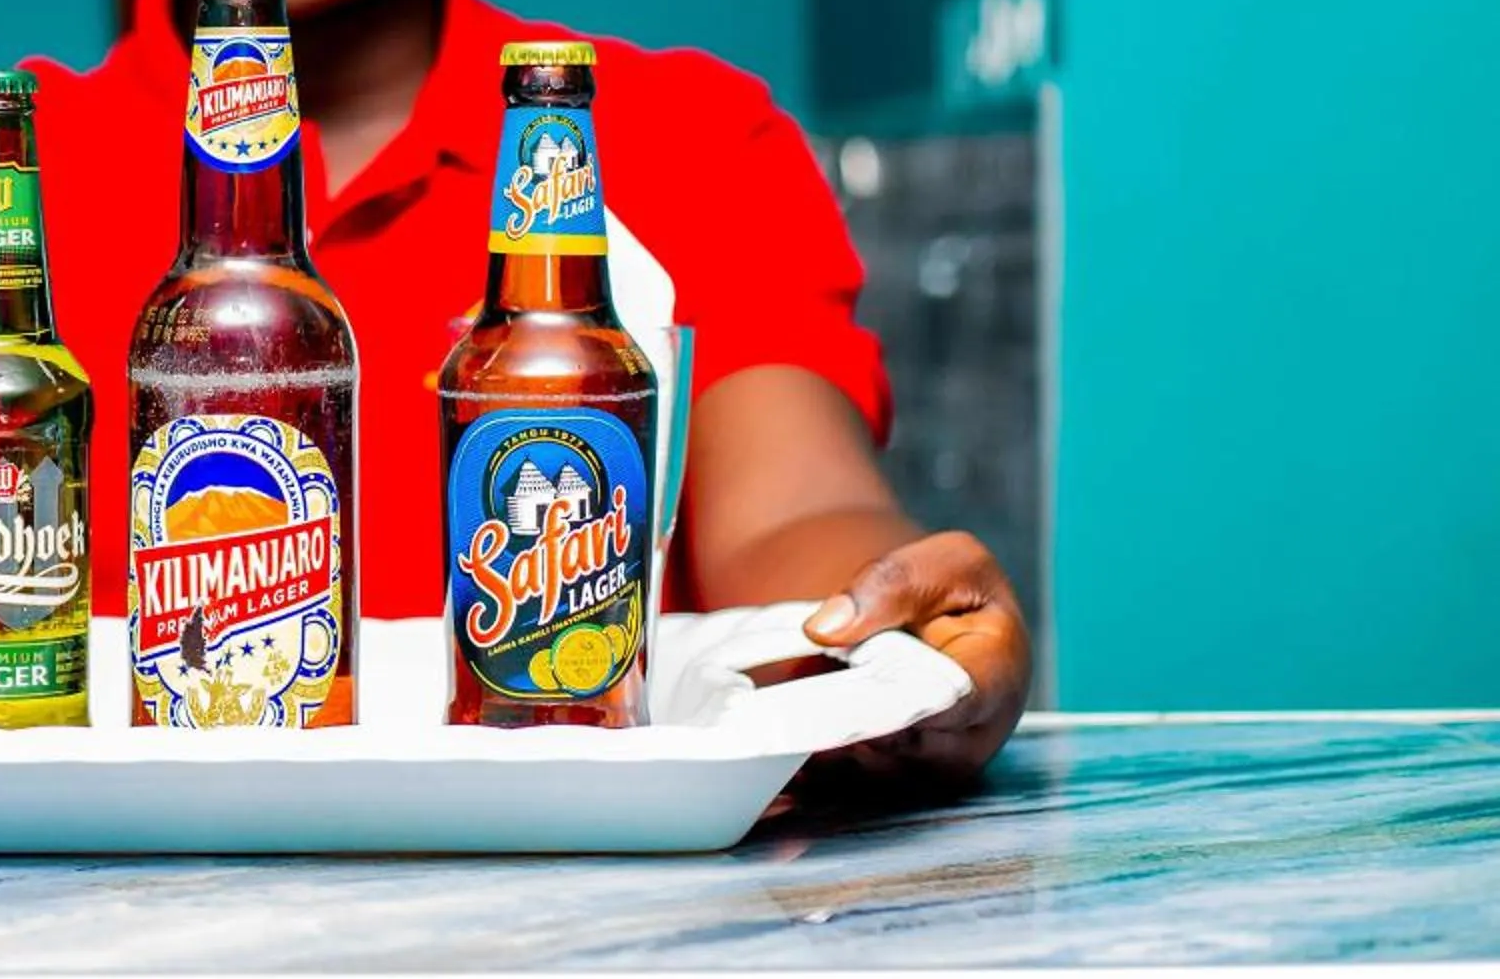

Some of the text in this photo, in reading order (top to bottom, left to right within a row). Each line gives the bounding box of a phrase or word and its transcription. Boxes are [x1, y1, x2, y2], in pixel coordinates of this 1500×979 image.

[504, 152, 596, 239] Safari
[231, 438, 257, 455] KWA
[260, 449, 301, 520] WATANZANIA
[143, 525, 326, 619] KILIMANJARO
[246, 579, 310, 615] LAGER
[457, 484, 631, 648] Safari
[568, 561, 627, 615] LAGER
